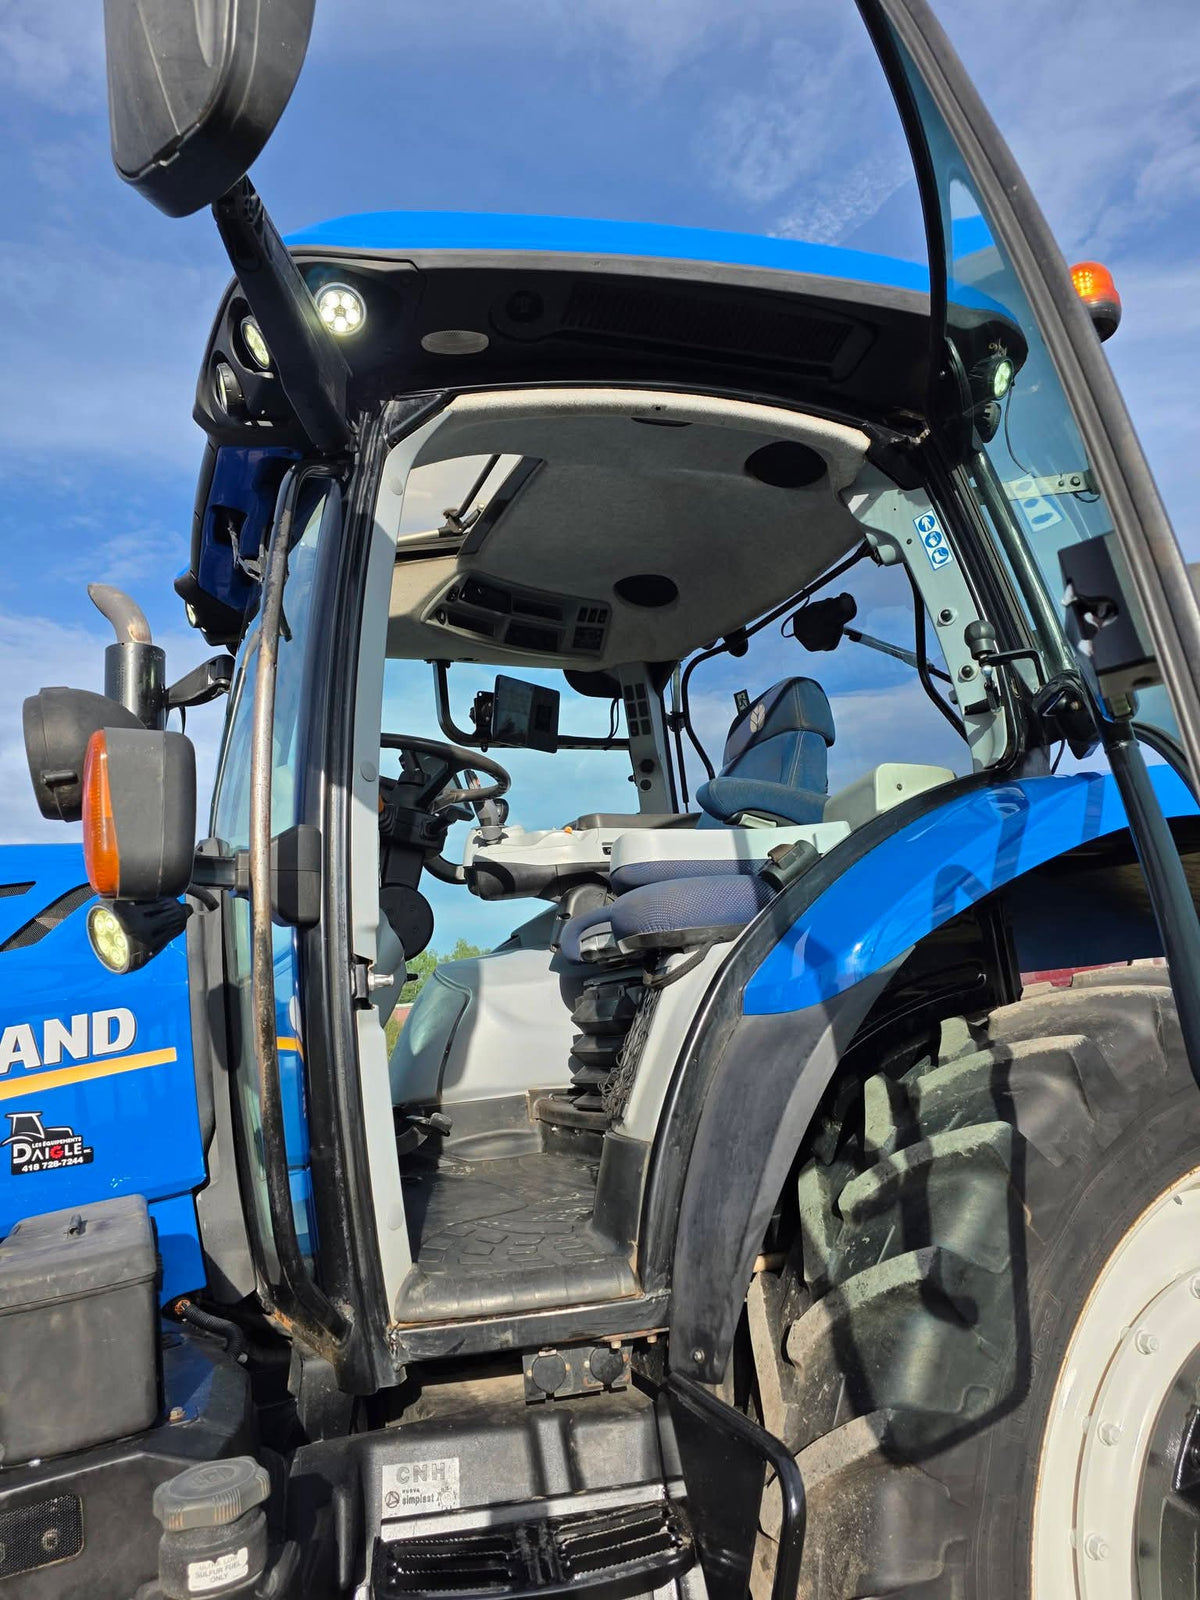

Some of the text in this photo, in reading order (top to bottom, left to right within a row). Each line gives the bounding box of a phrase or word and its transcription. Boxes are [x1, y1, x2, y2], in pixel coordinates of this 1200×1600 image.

[13, 1143, 82, 1164] DAIGLE
[21, 1156, 84, 1172] 418 728-7244
[396, 1462, 446, 1485] CNH
